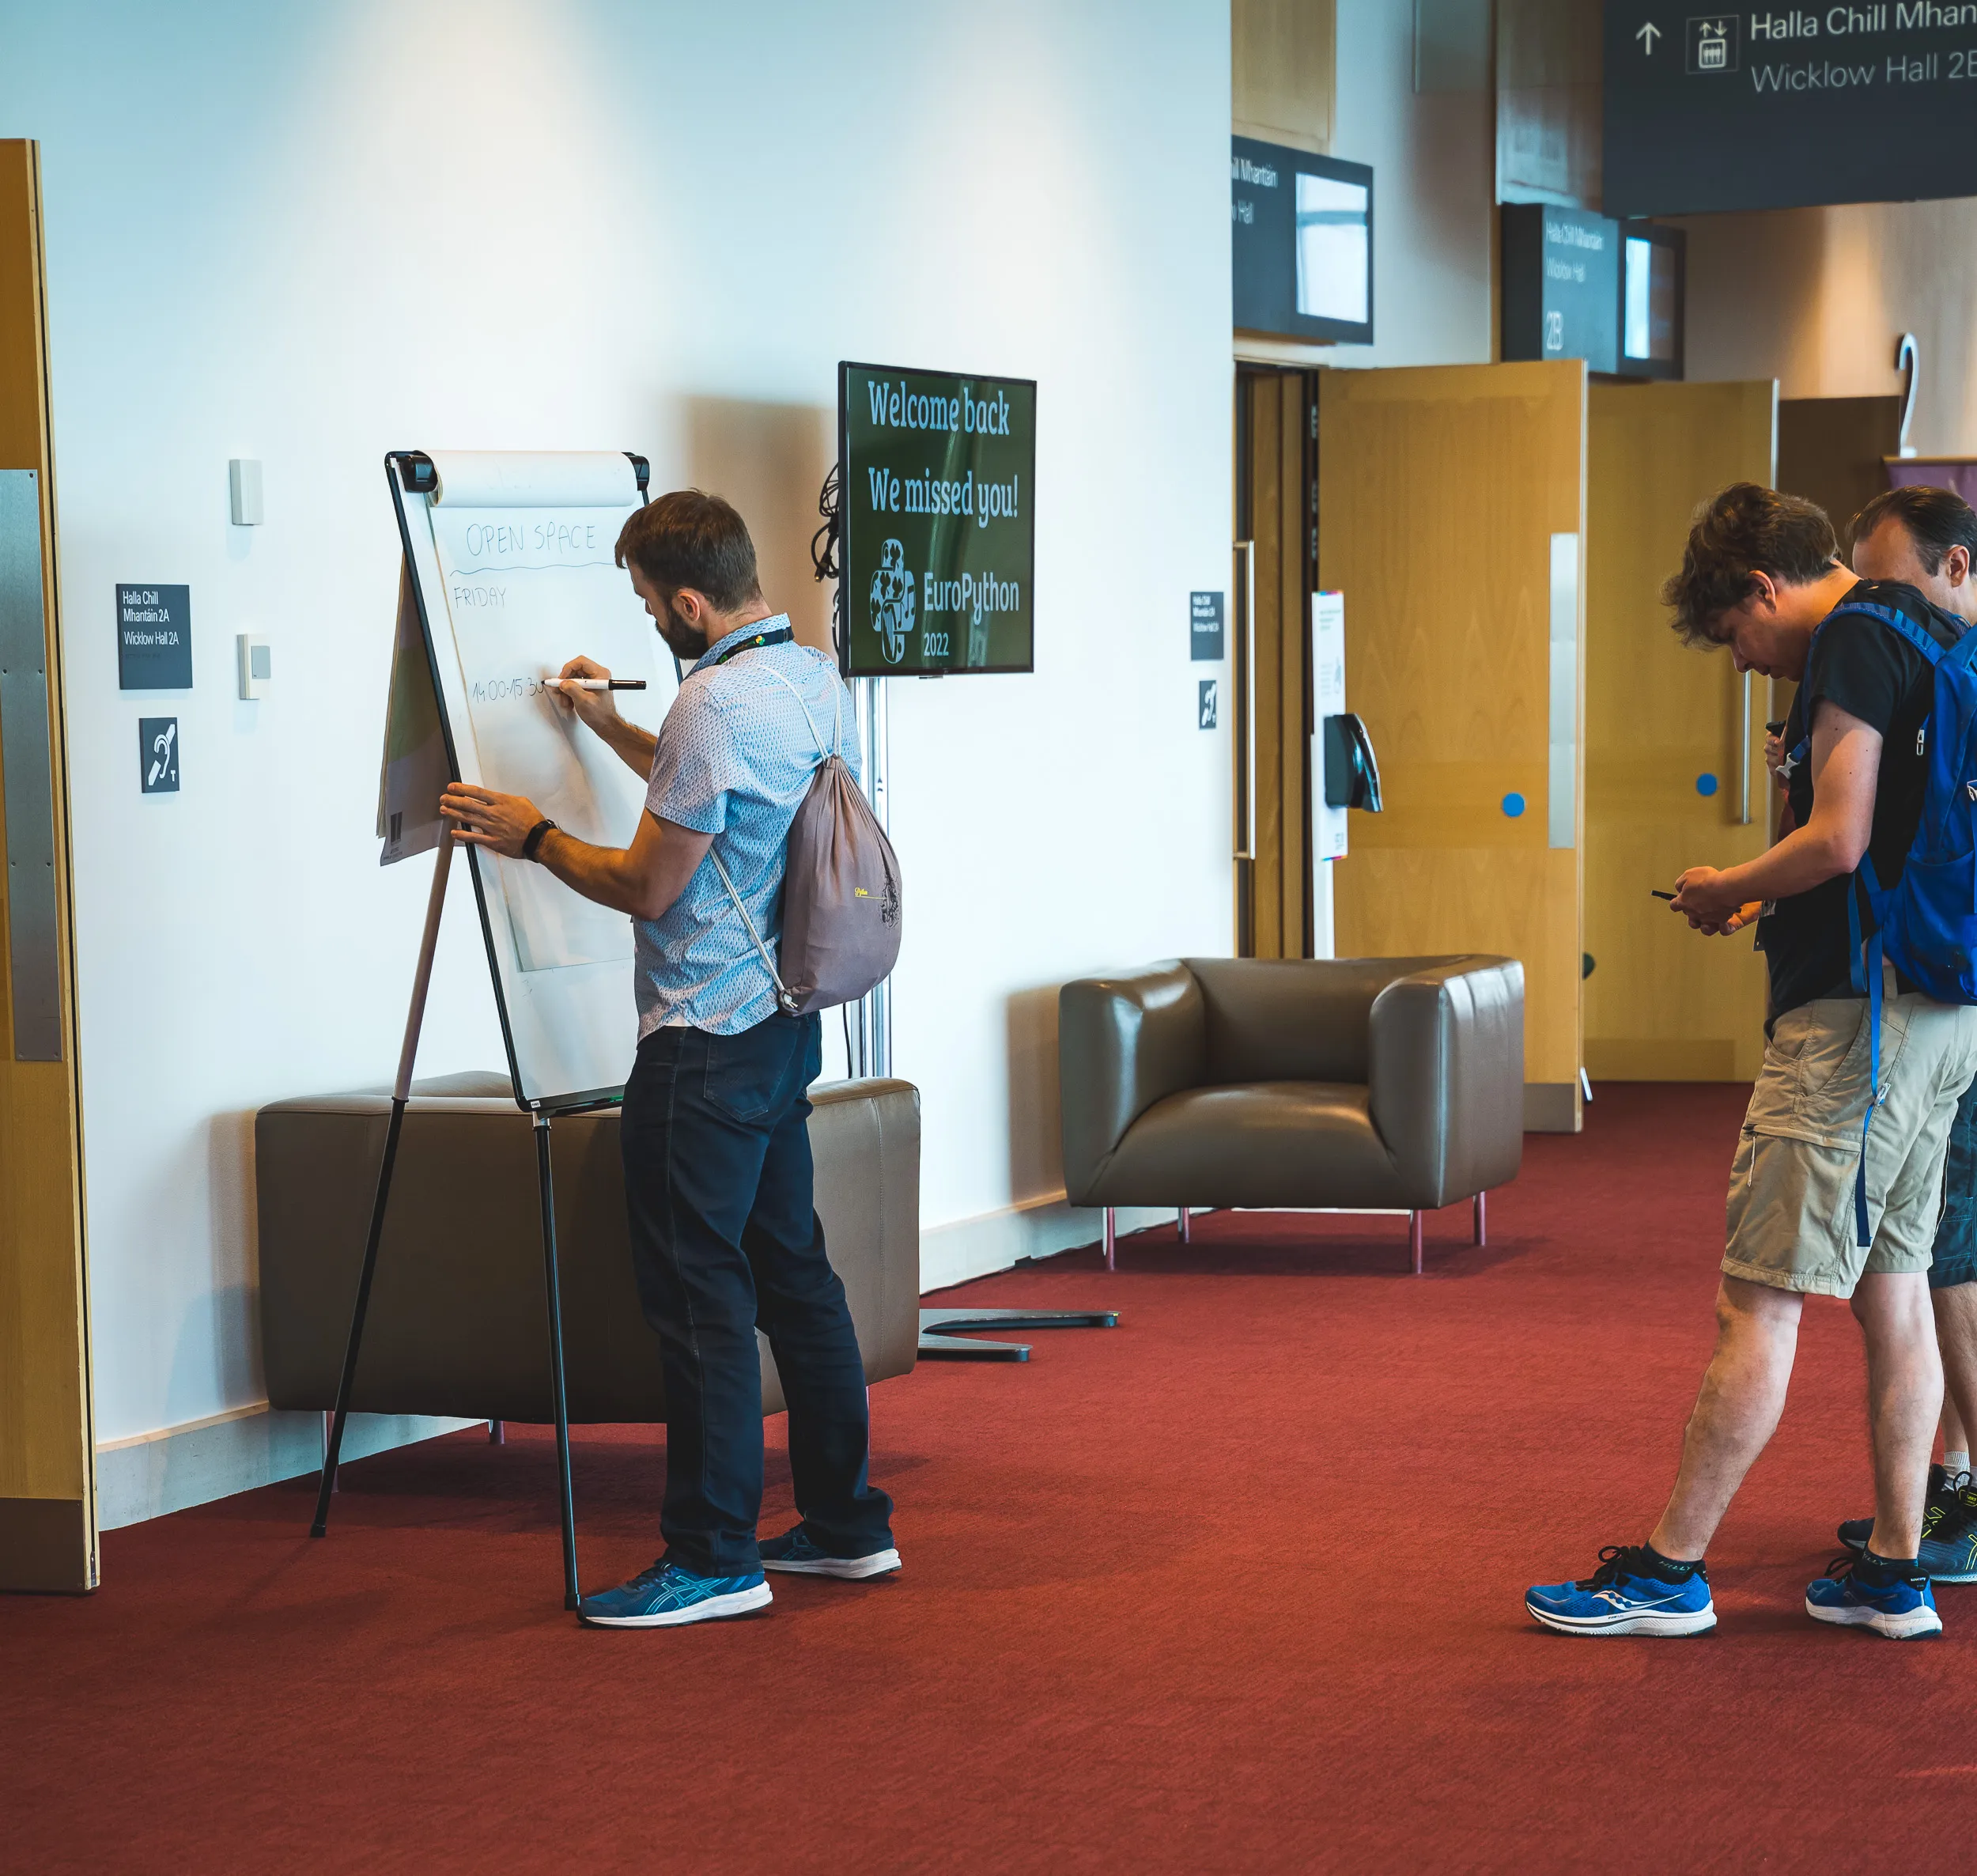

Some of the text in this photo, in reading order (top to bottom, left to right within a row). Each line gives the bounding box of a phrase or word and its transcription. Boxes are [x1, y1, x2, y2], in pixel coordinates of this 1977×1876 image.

[1751, 0, 1977, 40] Halla Chill Mhan
[1751, 60, 1876, 93] Wicklow
[1887, 51, 1938, 82] Hall
[868, 381, 1010, 435] Welcome back
[868, 467, 1019, 528] We missed you!
[467, 521, 596, 556] OPEN SPACE
[123, 591, 158, 605] Halla Chill
[123, 608, 170, 622] Mhantáin 2A
[454, 587, 507, 609] FRIDAY
[924, 572, 1019, 625] EuroPython
[123, 631, 180, 645] Wicklow Hall 2A
[924, 633, 949, 657] 2022
